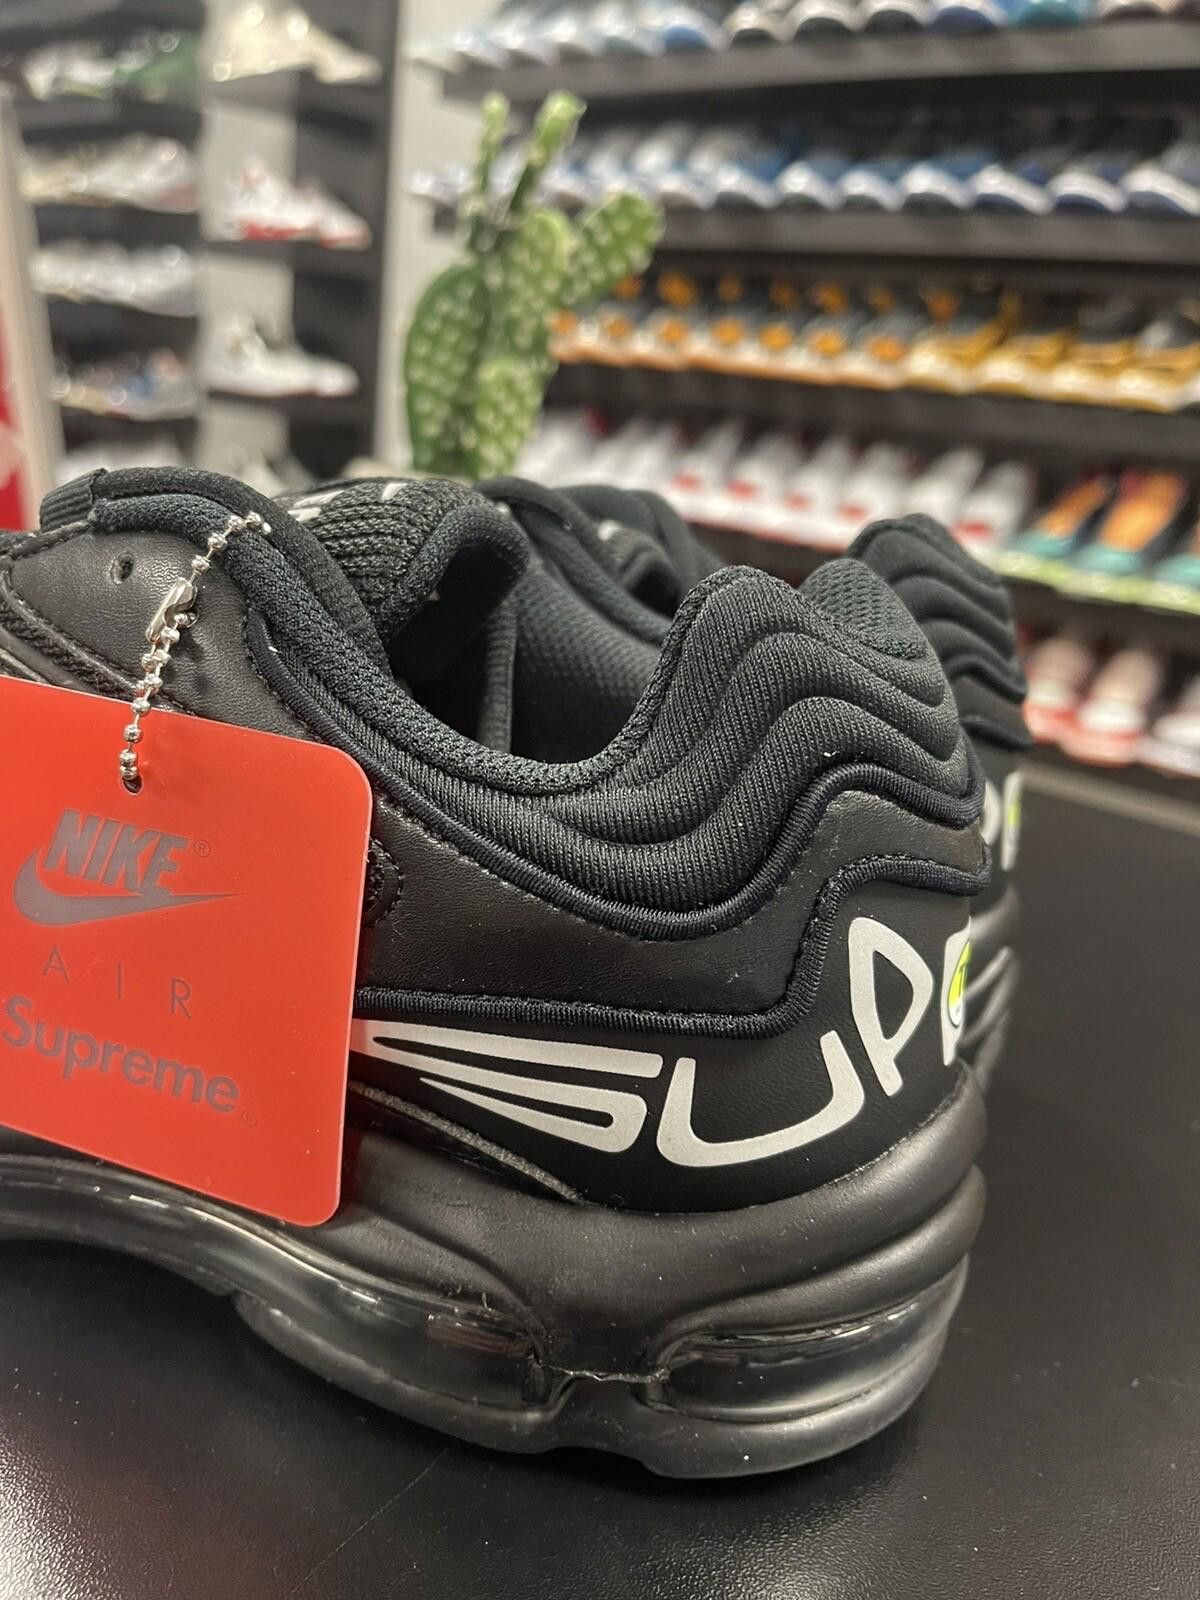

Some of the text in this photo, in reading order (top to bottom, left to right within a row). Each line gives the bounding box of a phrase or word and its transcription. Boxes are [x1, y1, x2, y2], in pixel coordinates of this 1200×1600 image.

[44, 808, 190, 897] NIKE
[42, 945, 193, 1020] AIR
[1, 995, 240, 1113] Supreme
